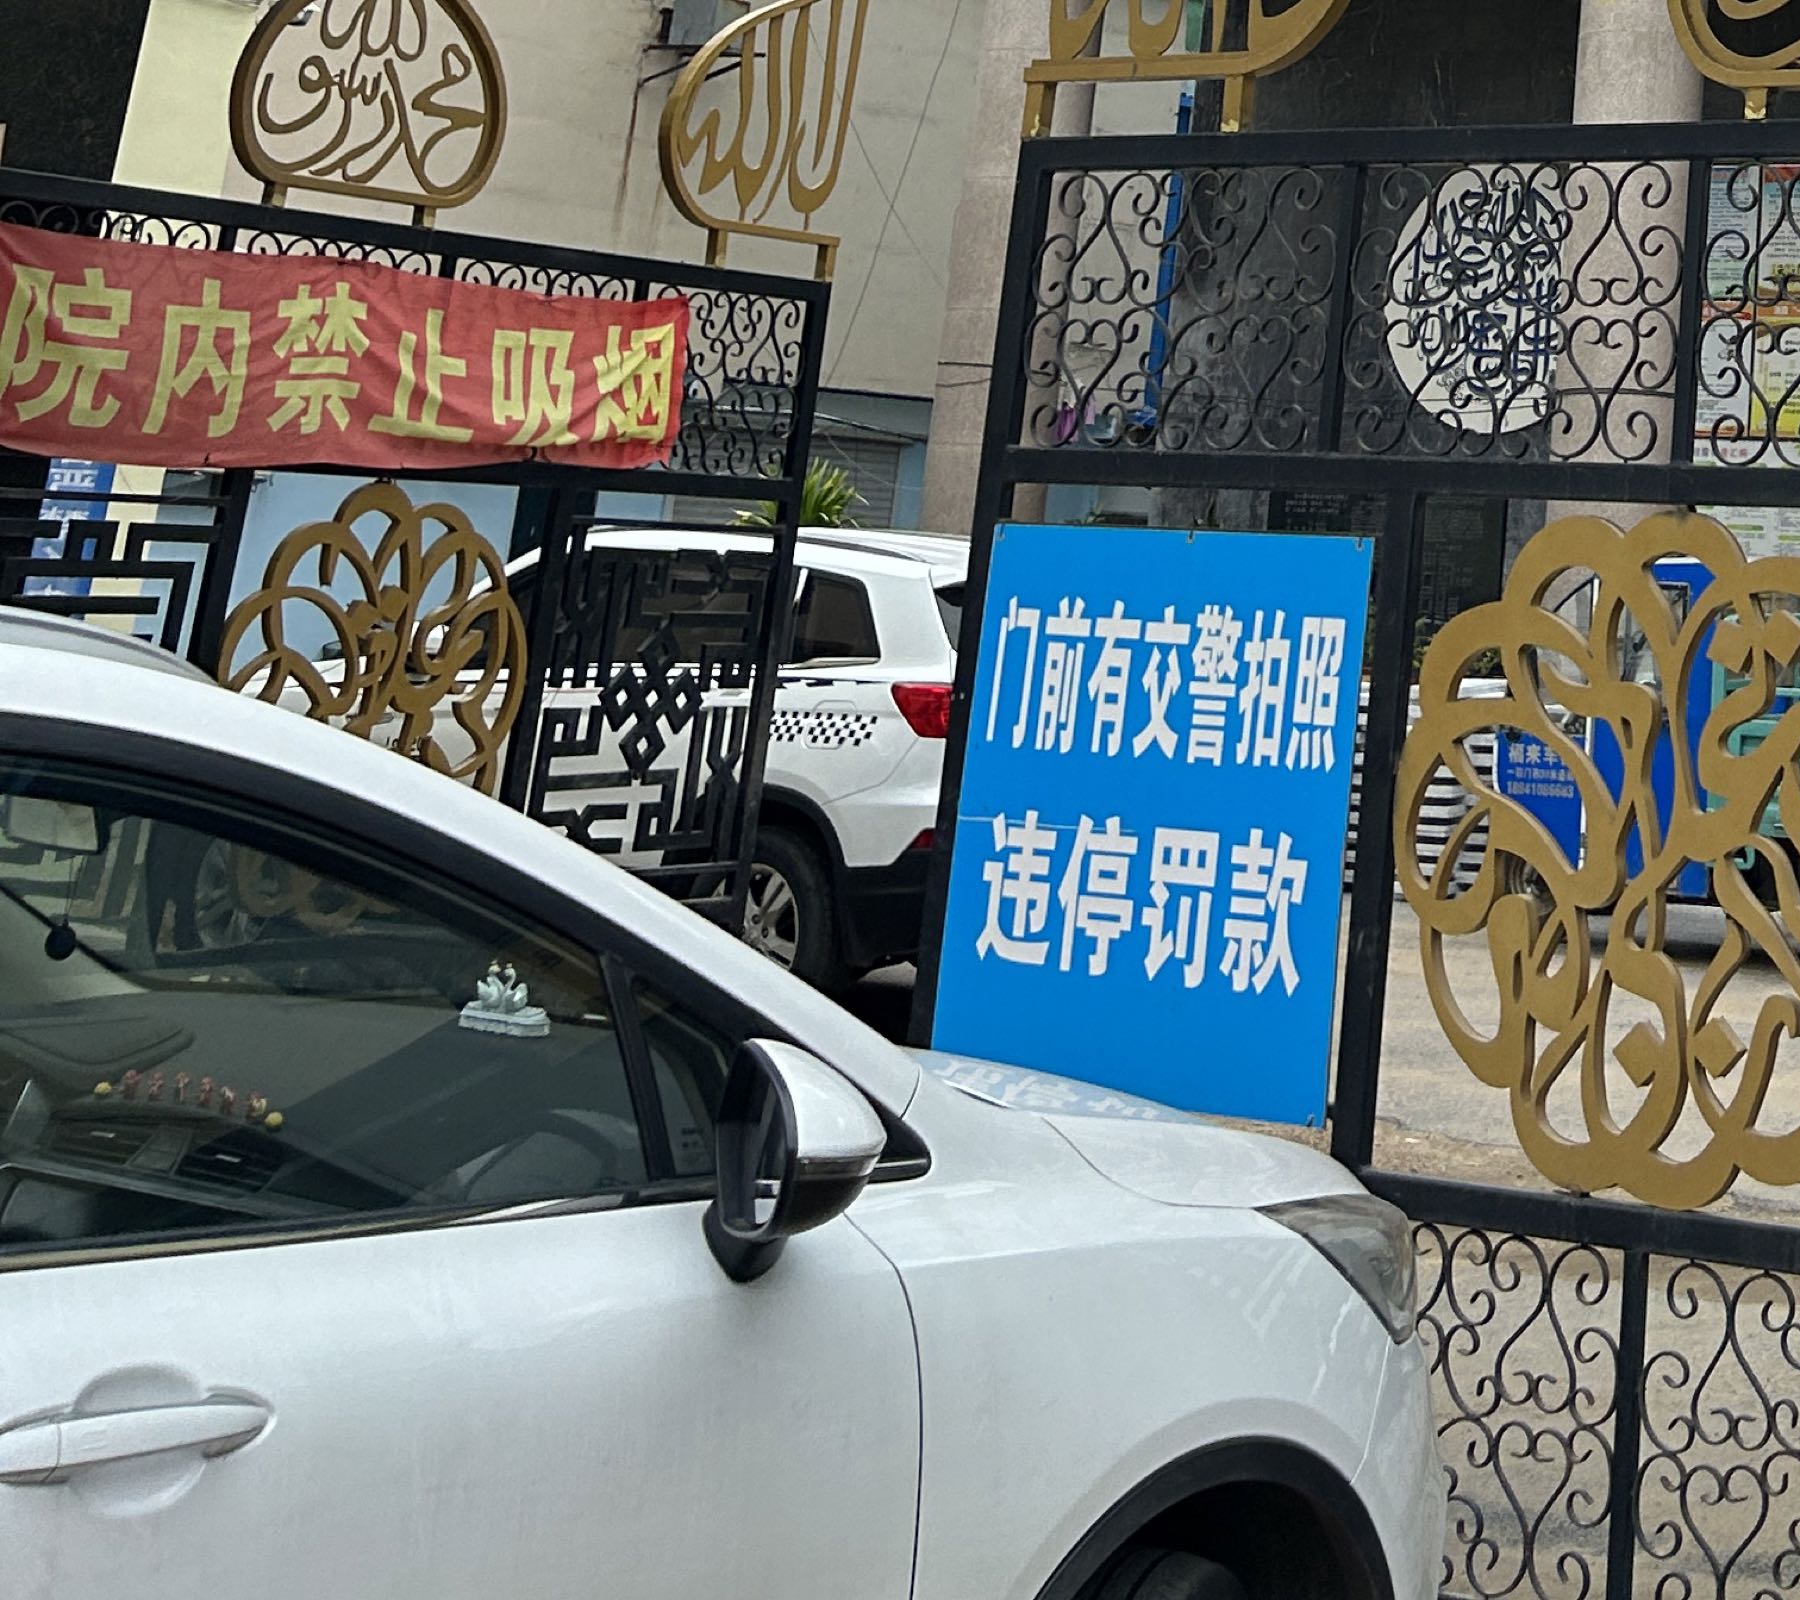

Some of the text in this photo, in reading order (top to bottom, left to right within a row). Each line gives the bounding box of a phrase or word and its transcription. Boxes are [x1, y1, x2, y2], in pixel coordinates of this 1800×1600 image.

[1, 262, 677, 446] 院内禁止吸烟
[985, 596, 1347, 773] 门前有交警拍照
[975, 809, 1309, 997] 违停罚款
